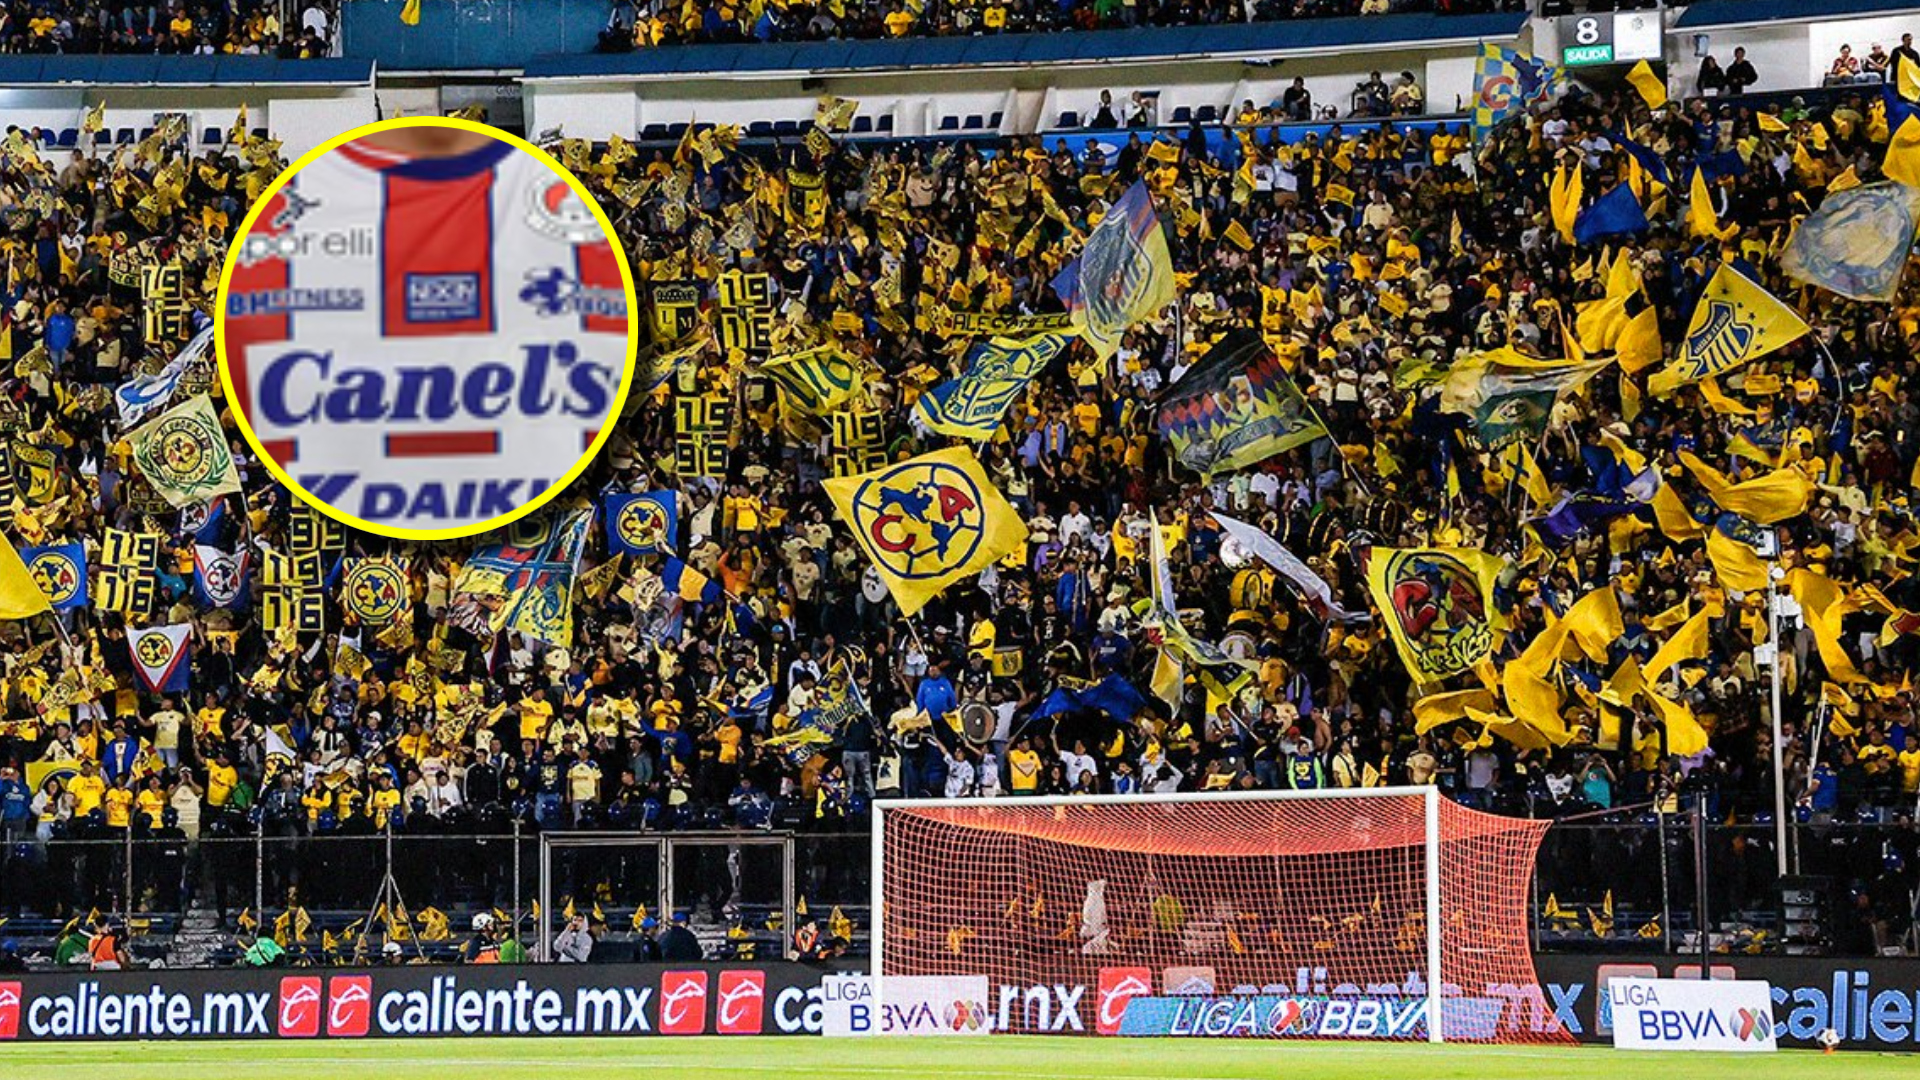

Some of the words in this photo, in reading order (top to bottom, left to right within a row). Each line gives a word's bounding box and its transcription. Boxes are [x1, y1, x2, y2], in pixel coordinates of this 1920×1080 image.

[1576, 18, 1599, 44] 8
[1567, 49, 1609, 61] SALIDA
[723, 278, 769, 306] 19
[726, 316, 769, 347] 16
[257, 341, 613, 428] Canel's
[836, 415, 884, 446] 19
[109, 532, 156, 570] 19
[267, 551, 320, 588] 19
[104, 574, 152, 613] 16
[267, 594, 322, 631] 16
[26, 982, 271, 1036] caliente.mx
[377, 976, 652, 1035] caliente.mx
[825, 983, 872, 1001] LIGA
[1611, 985, 1660, 1006] LIGA
[1170, 1000, 1258, 1036] LIGA
[1638, 1008, 1726, 1041] BBVA
